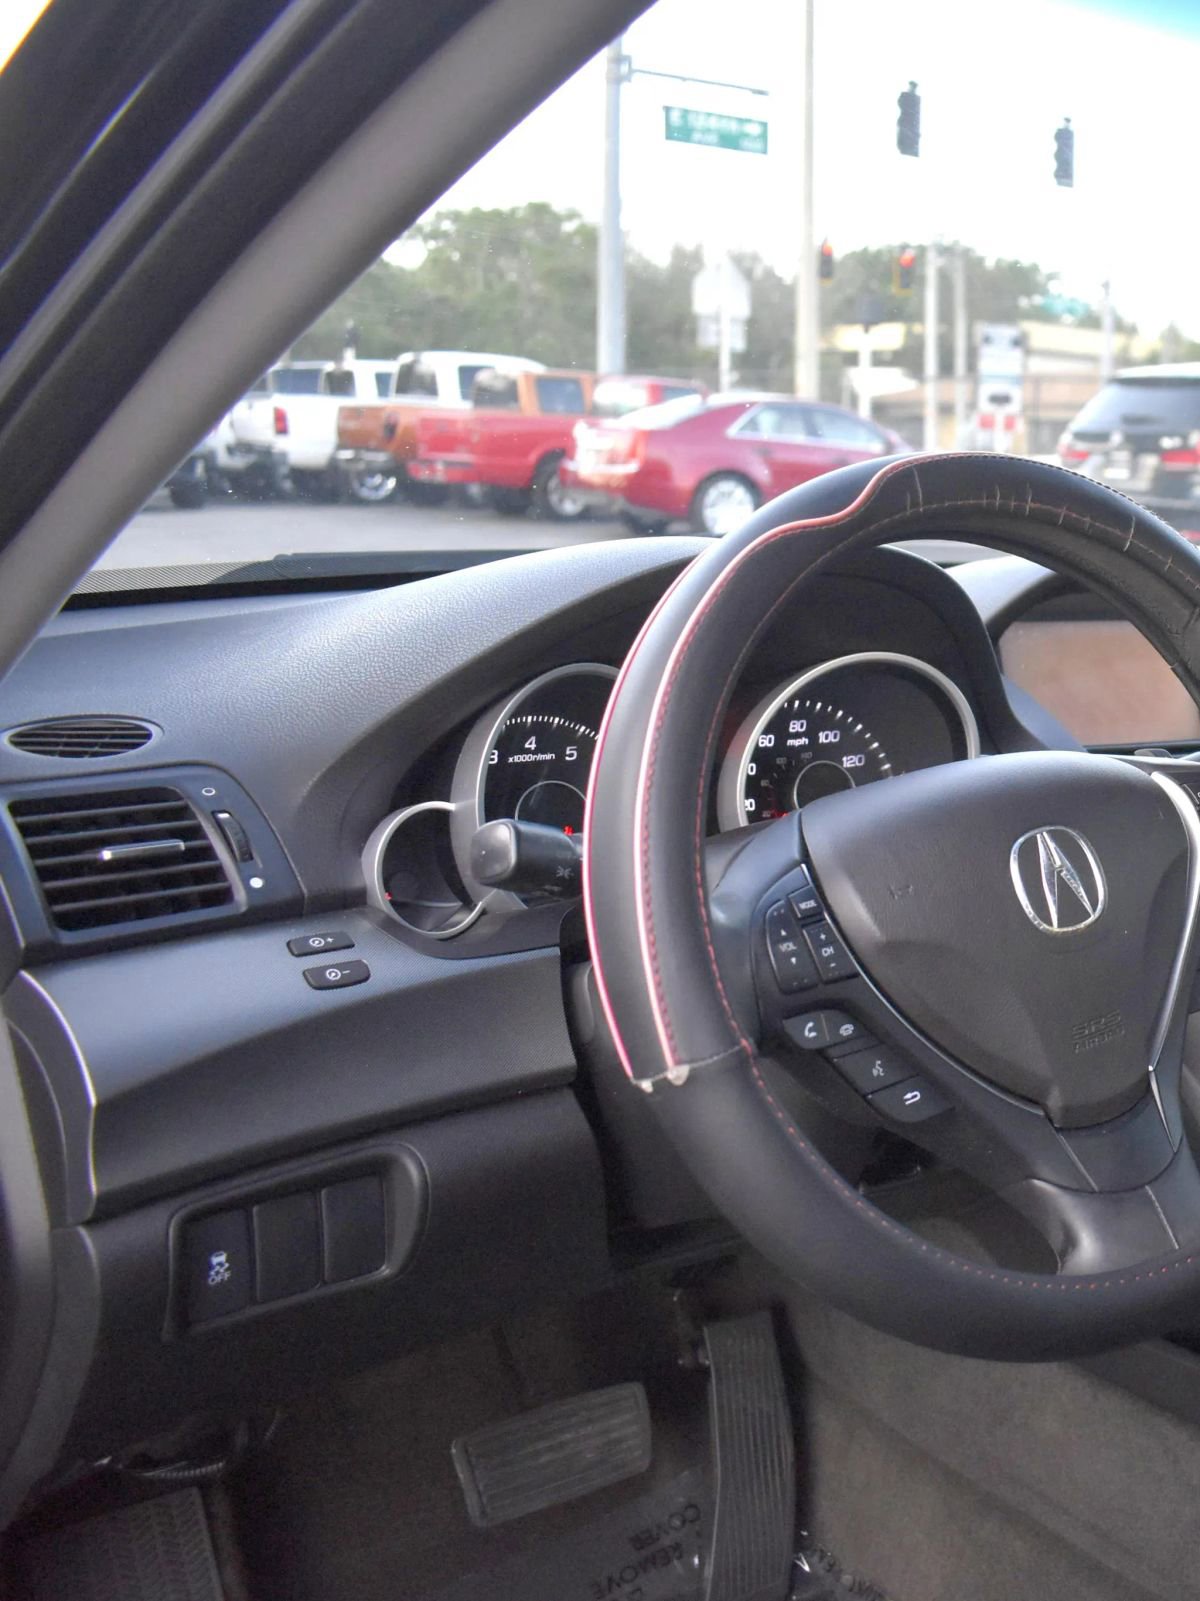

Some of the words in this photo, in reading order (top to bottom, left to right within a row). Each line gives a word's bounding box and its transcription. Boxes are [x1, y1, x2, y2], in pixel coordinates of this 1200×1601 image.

[789, 719, 807, 733] 80
[524, 735, 537, 750] 4
[758, 734, 775, 747] 60
[786, 737, 809, 747] mph
[818, 730, 841, 744] 100
[488, 749, 499, 764] 3
[507, 752, 556, 763] x1000r/min
[564, 746, 578, 761] 5
[842, 754, 866, 768] 120
[778, 941, 797, 952] VOL
[821, 945, 835, 957] CH
[207, 1271, 232, 1286] OFF
